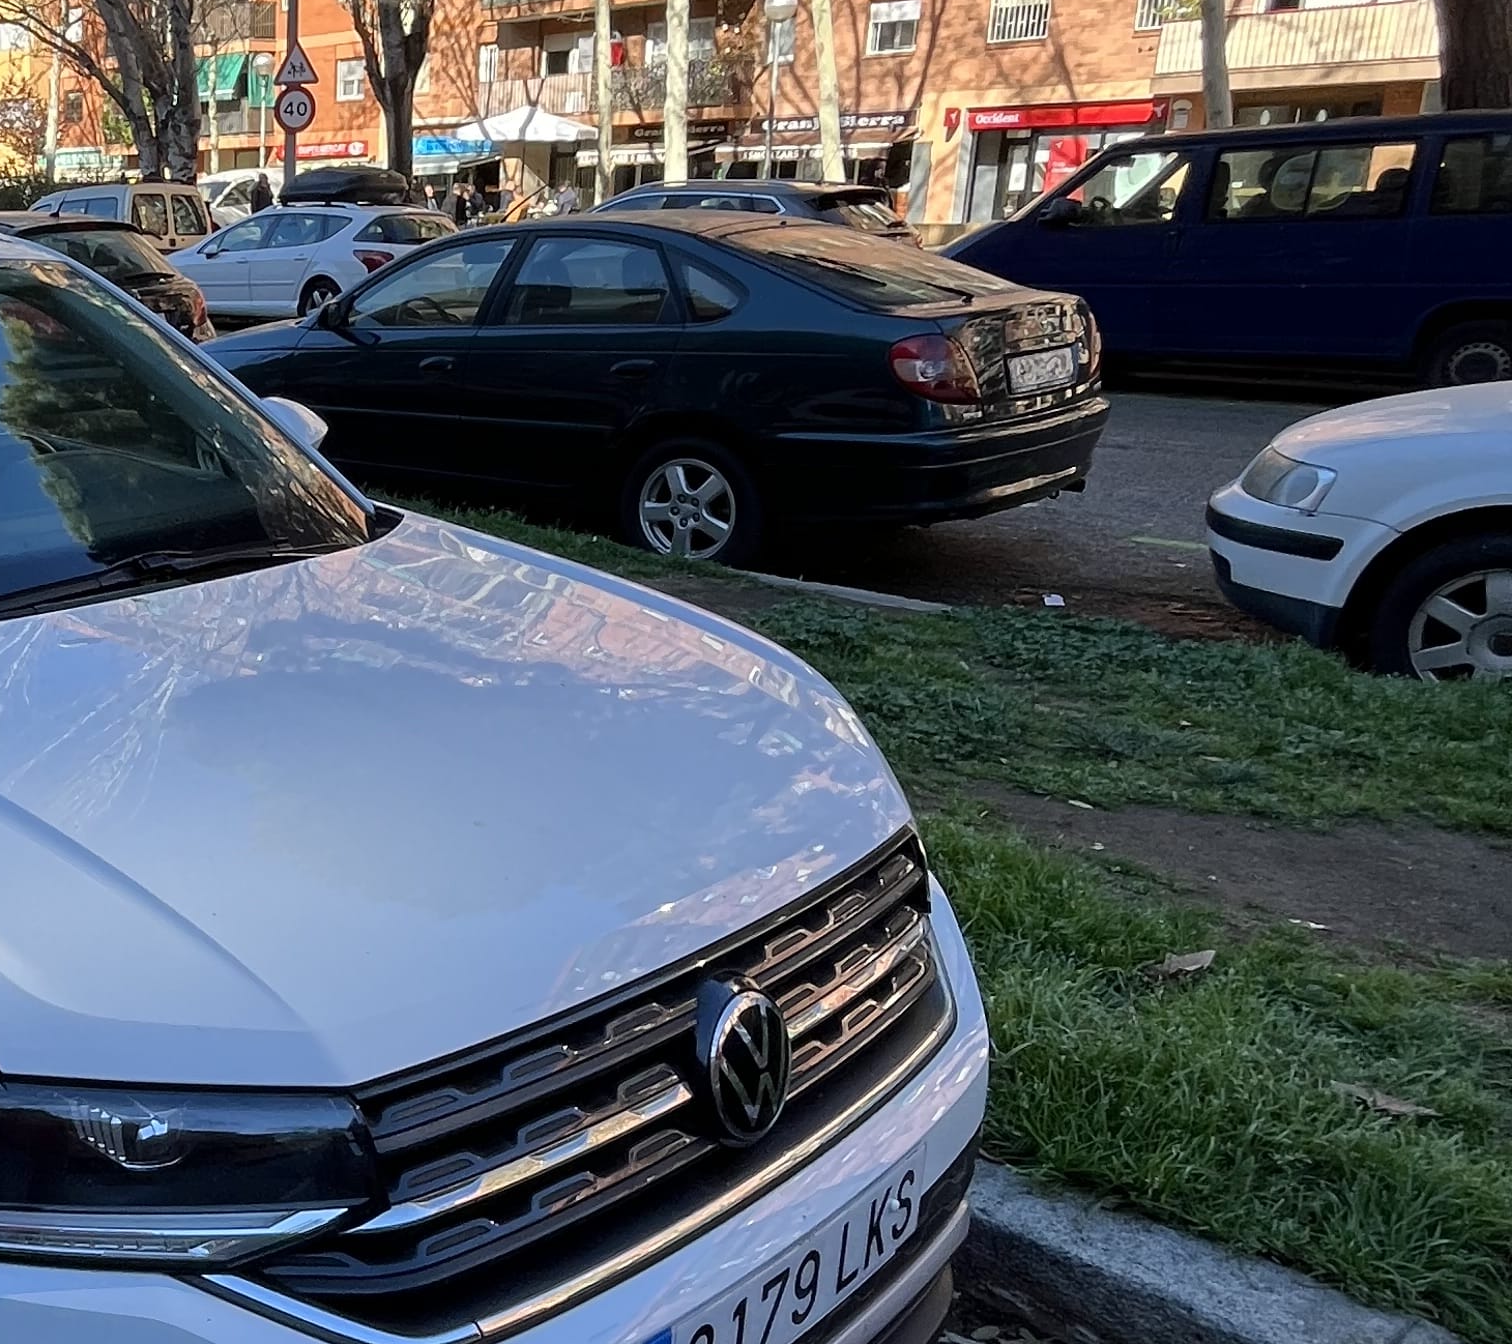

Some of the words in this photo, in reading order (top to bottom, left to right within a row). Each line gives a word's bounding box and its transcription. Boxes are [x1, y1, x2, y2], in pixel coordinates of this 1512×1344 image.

[283, 101, 308, 116] 40
[761, 117, 821, 131] Granj
[975, 111, 1020, 124] Occident
[836, 1169, 915, 1295] LKS
